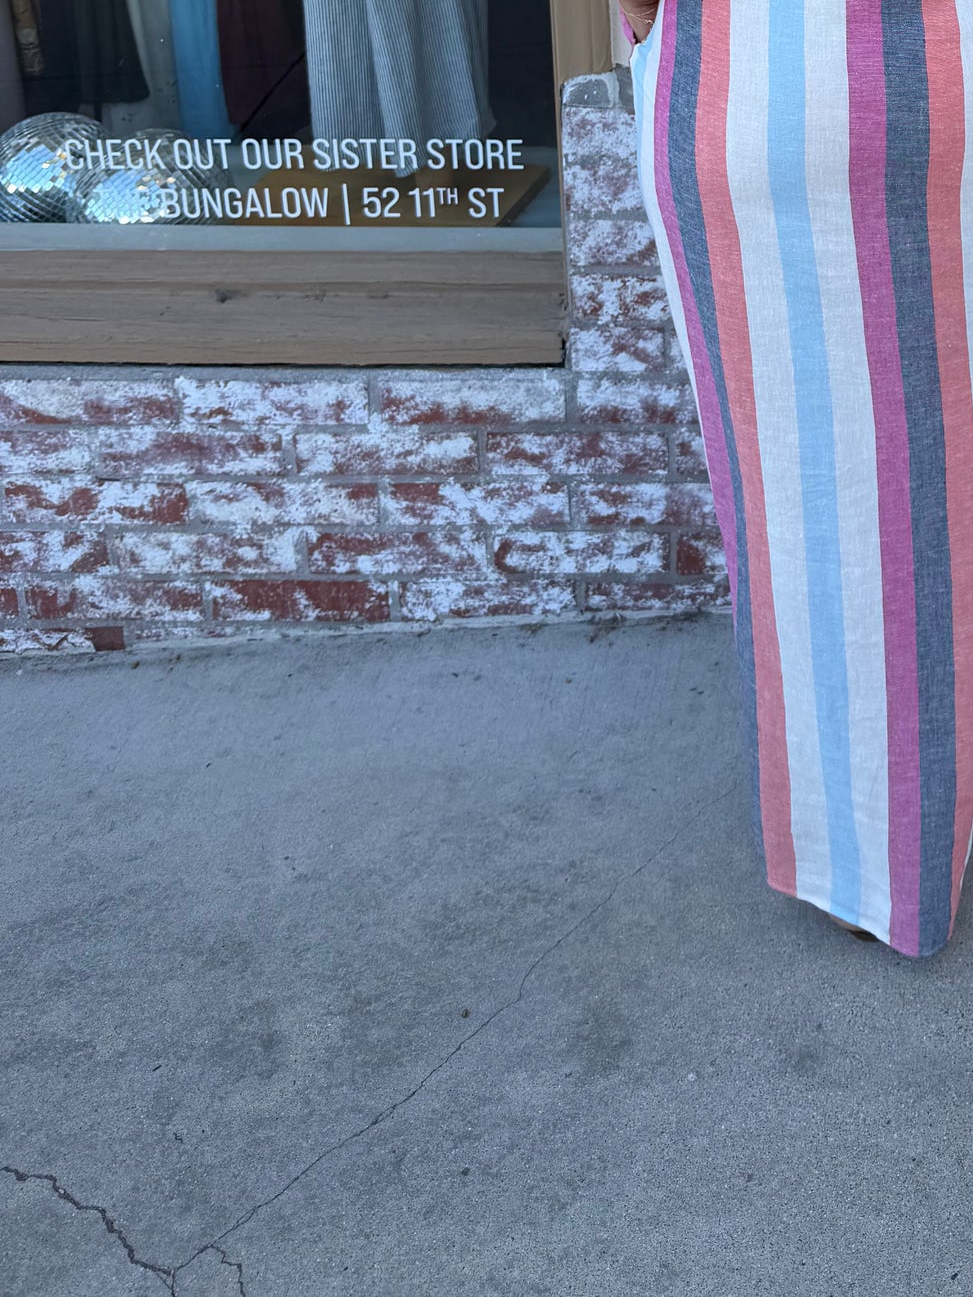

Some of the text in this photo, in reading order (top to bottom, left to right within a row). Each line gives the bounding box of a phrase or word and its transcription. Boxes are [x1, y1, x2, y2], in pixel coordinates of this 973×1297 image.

[64, 138, 525, 170] CHECK OUT OUR SISTER STORE
[160, 187, 329, 219] BUNGALOW
[362, 187, 401, 219] 52
[408, 187, 459, 218] 11TH
[467, 187, 505, 219] ST
